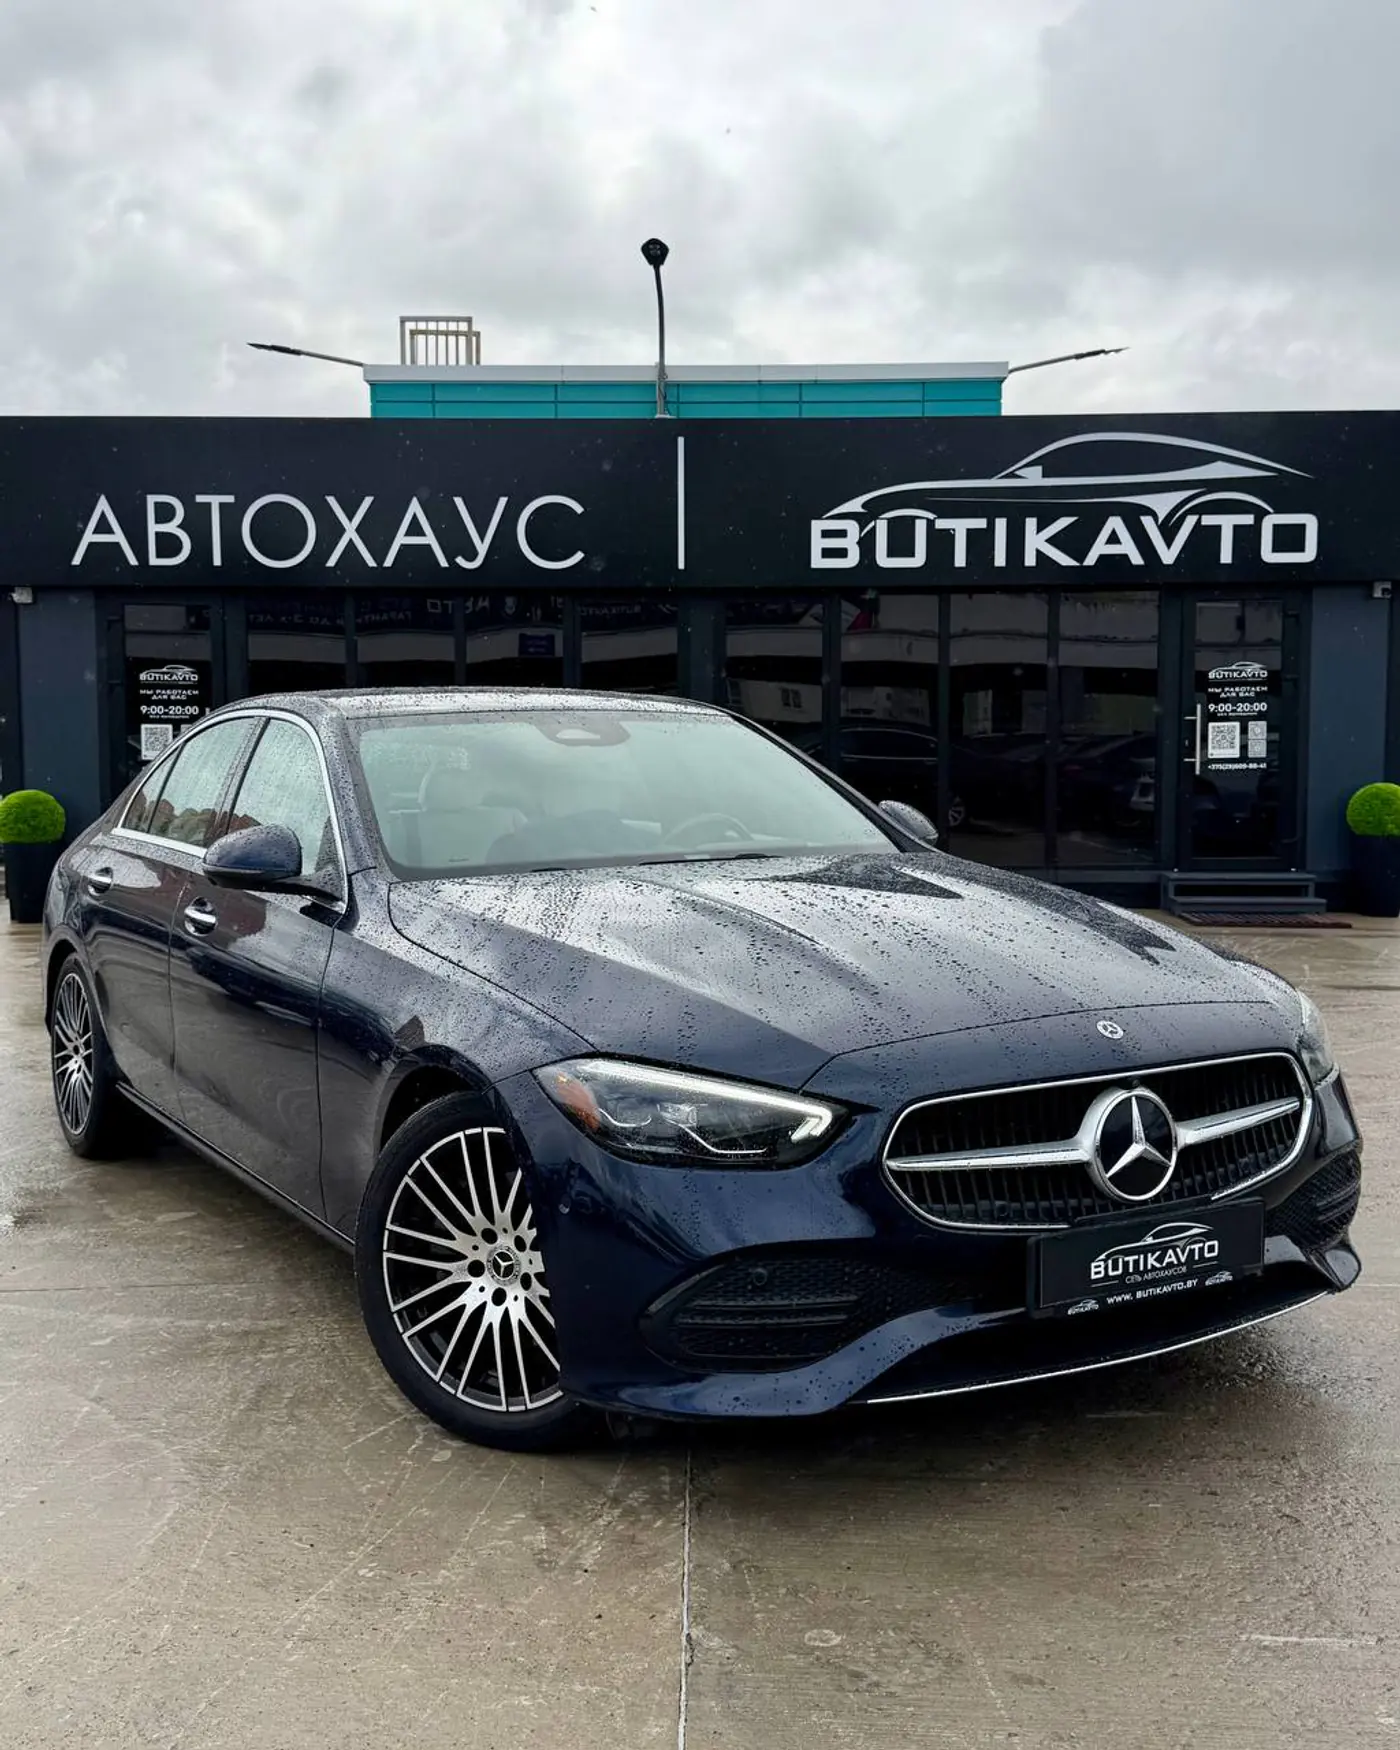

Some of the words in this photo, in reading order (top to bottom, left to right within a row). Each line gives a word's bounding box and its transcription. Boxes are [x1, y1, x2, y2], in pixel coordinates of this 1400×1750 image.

[71, 493, 586, 570] АВТОХАУС
[810, 512, 1319, 569] BUTIKAVTO
[139, 673, 199, 681] BUTIKAVTO
[1208, 670, 1268, 679] BUTIKAVTO
[140, 705, 199, 715] 9:00-20:00
[1208, 702, 1268, 712] 9:00-20:00
[1090, 1239, 1219, 1280] BUTIKAVTO
